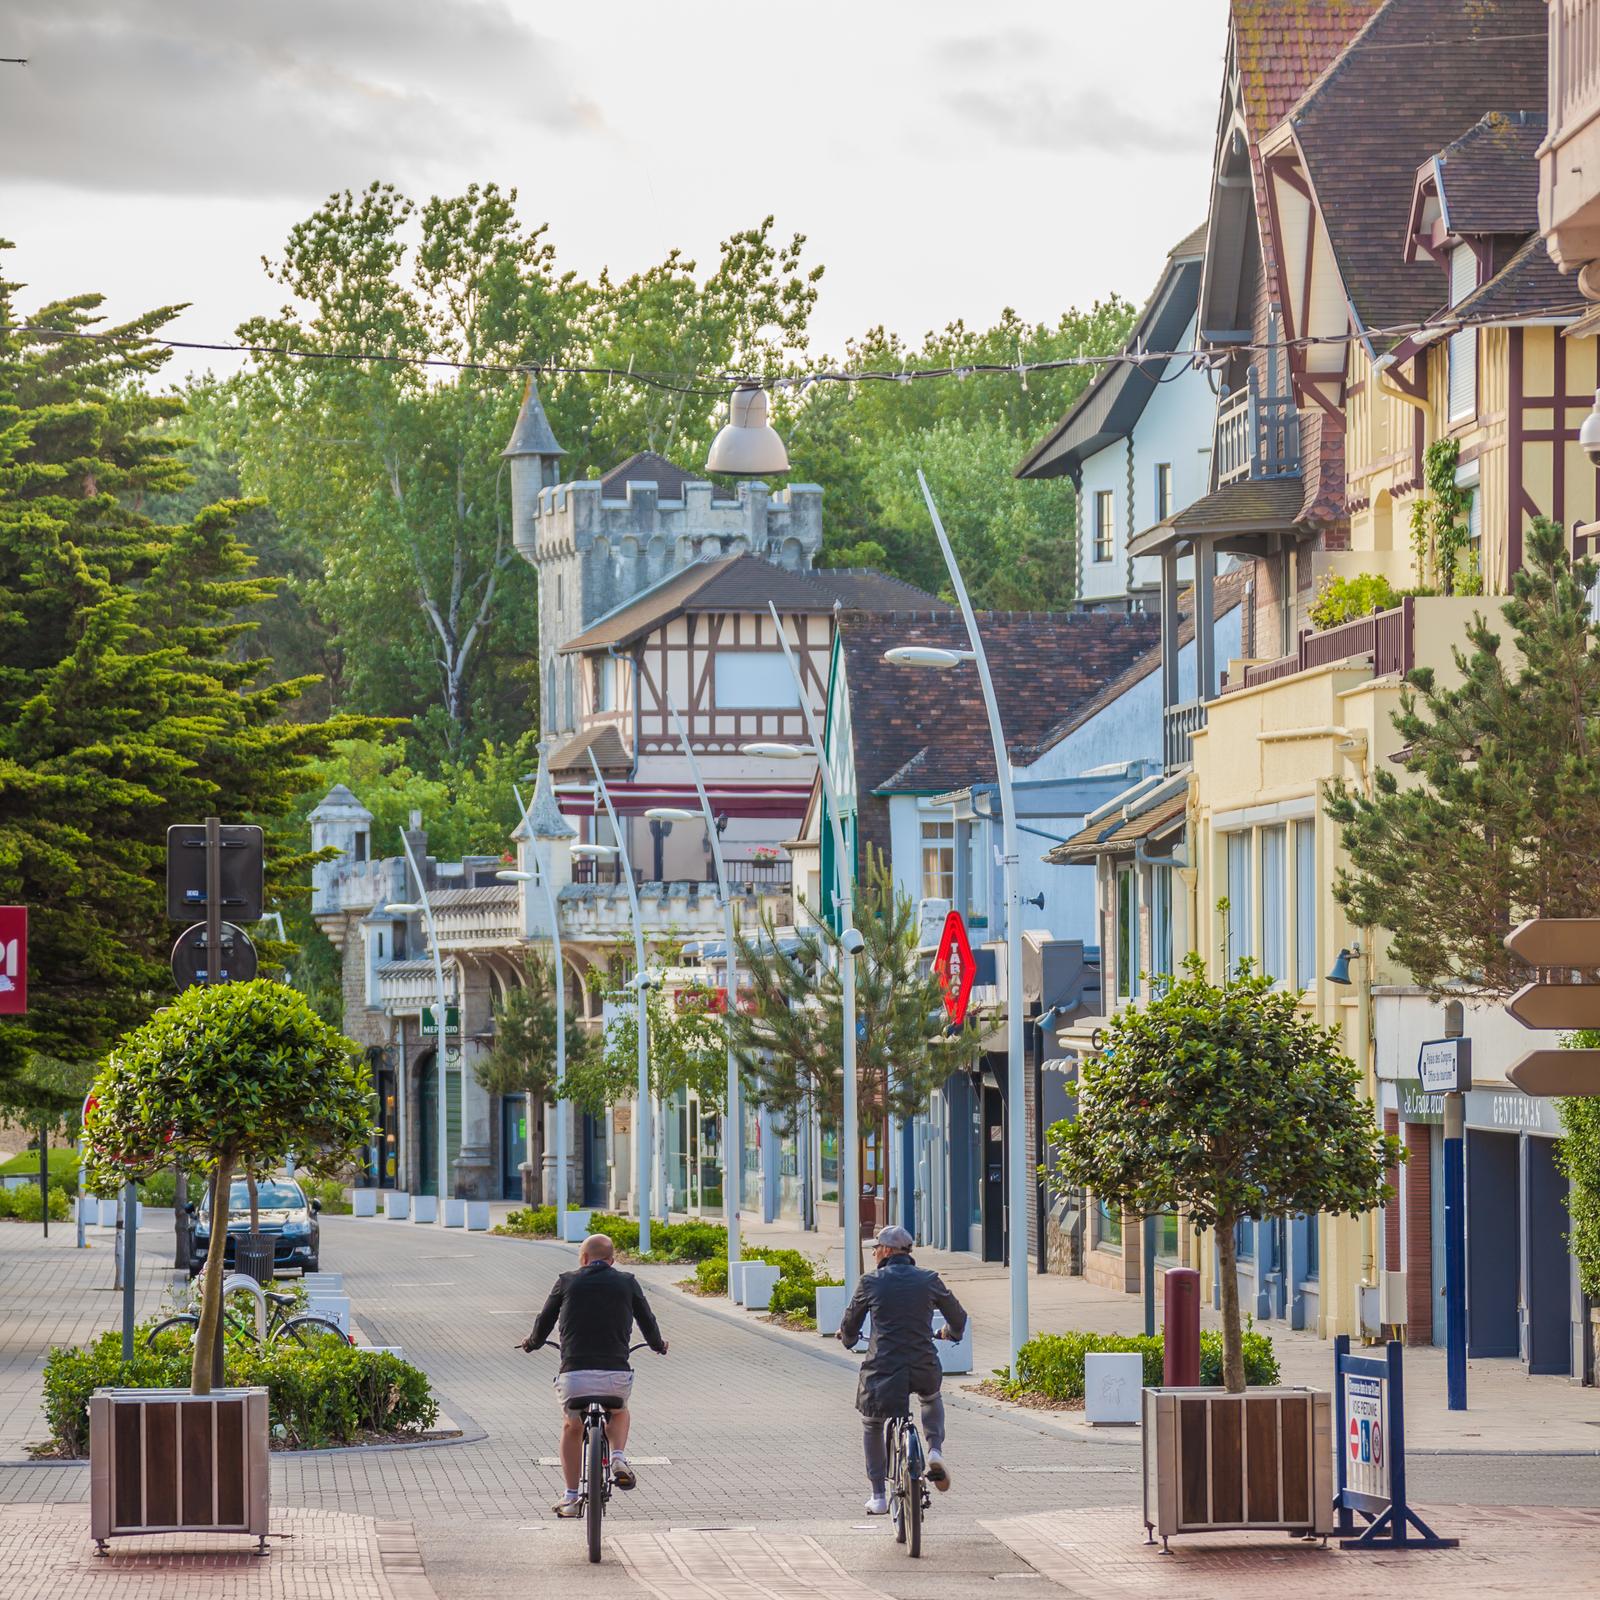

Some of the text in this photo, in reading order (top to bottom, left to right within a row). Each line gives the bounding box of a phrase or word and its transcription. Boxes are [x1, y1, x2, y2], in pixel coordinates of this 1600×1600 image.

[949, 942, 961, 996] TABAC
[423, 1025, 458, 1033] MEPSTO
[1493, 1096, 1541, 1127] GENTLEMAN
